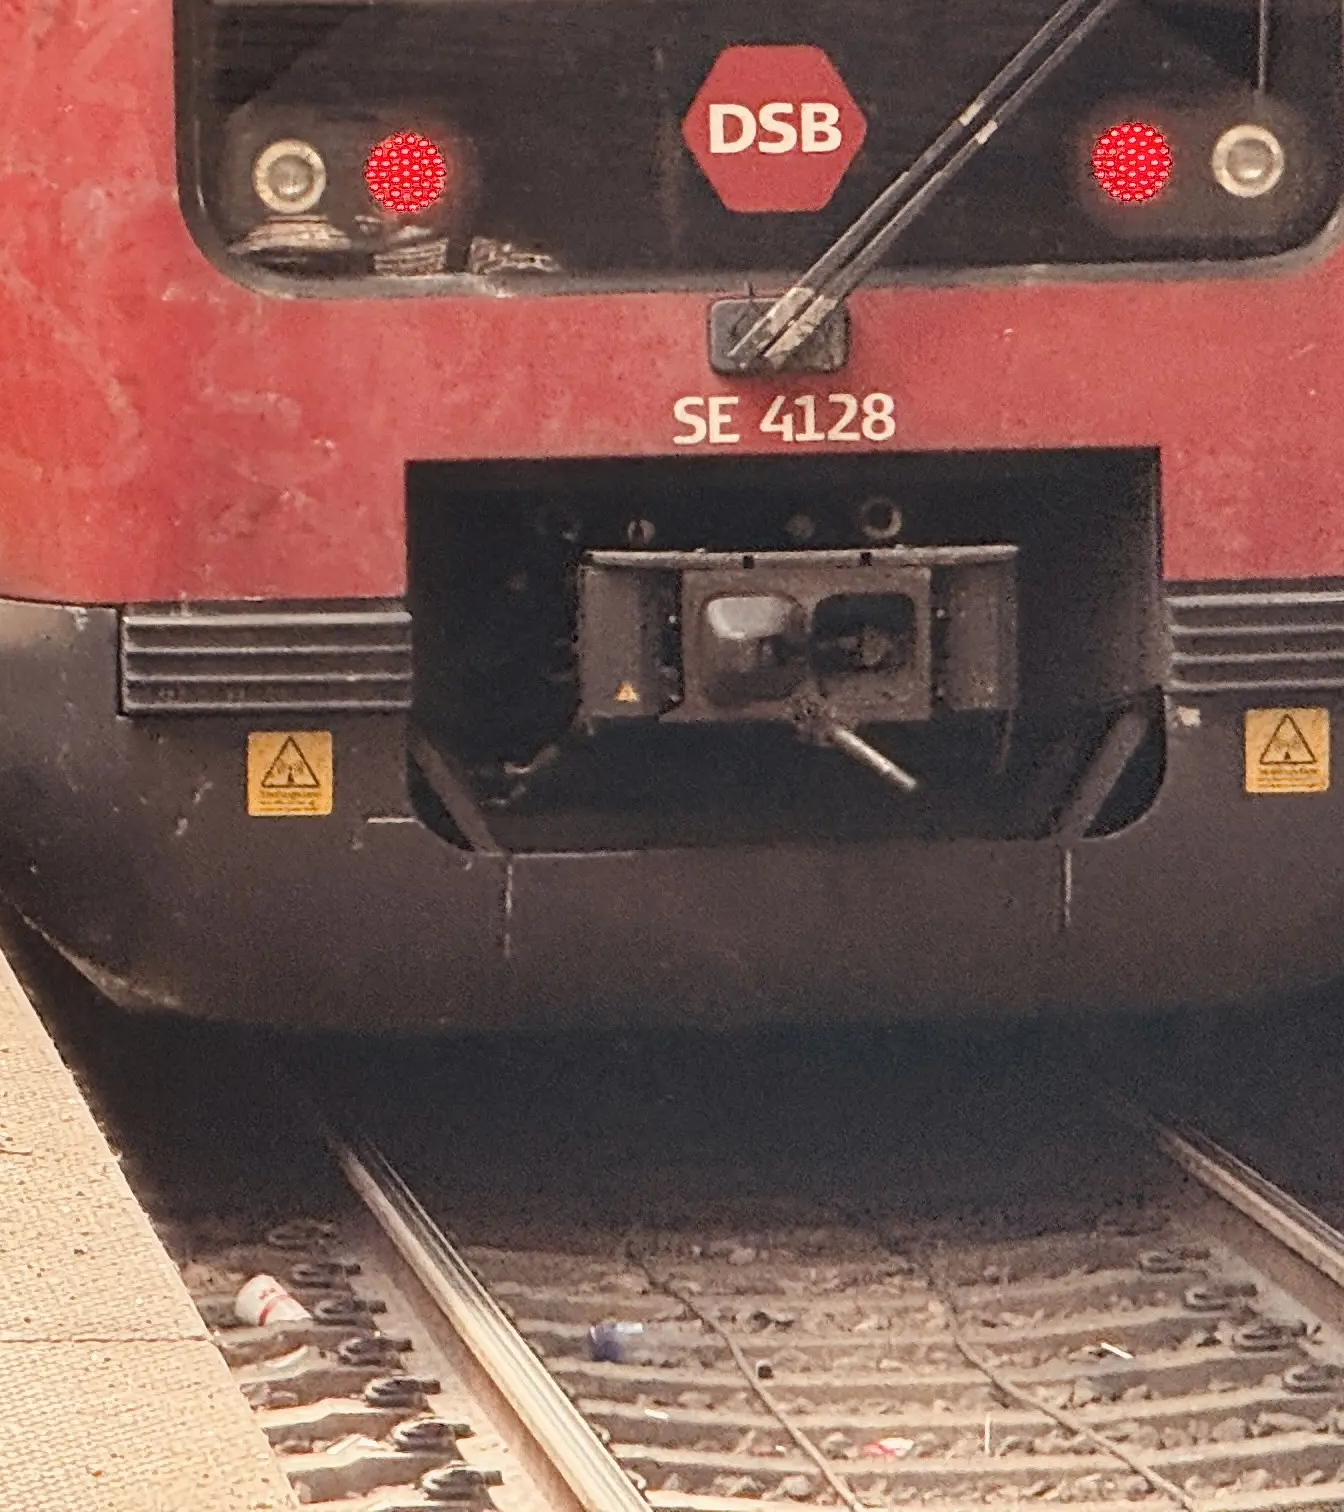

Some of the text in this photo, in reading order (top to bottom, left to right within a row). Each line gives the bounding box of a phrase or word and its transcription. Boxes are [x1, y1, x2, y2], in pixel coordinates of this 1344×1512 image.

[709, 102, 842, 154] DSB
[672, 392, 896, 445] SE 4128
